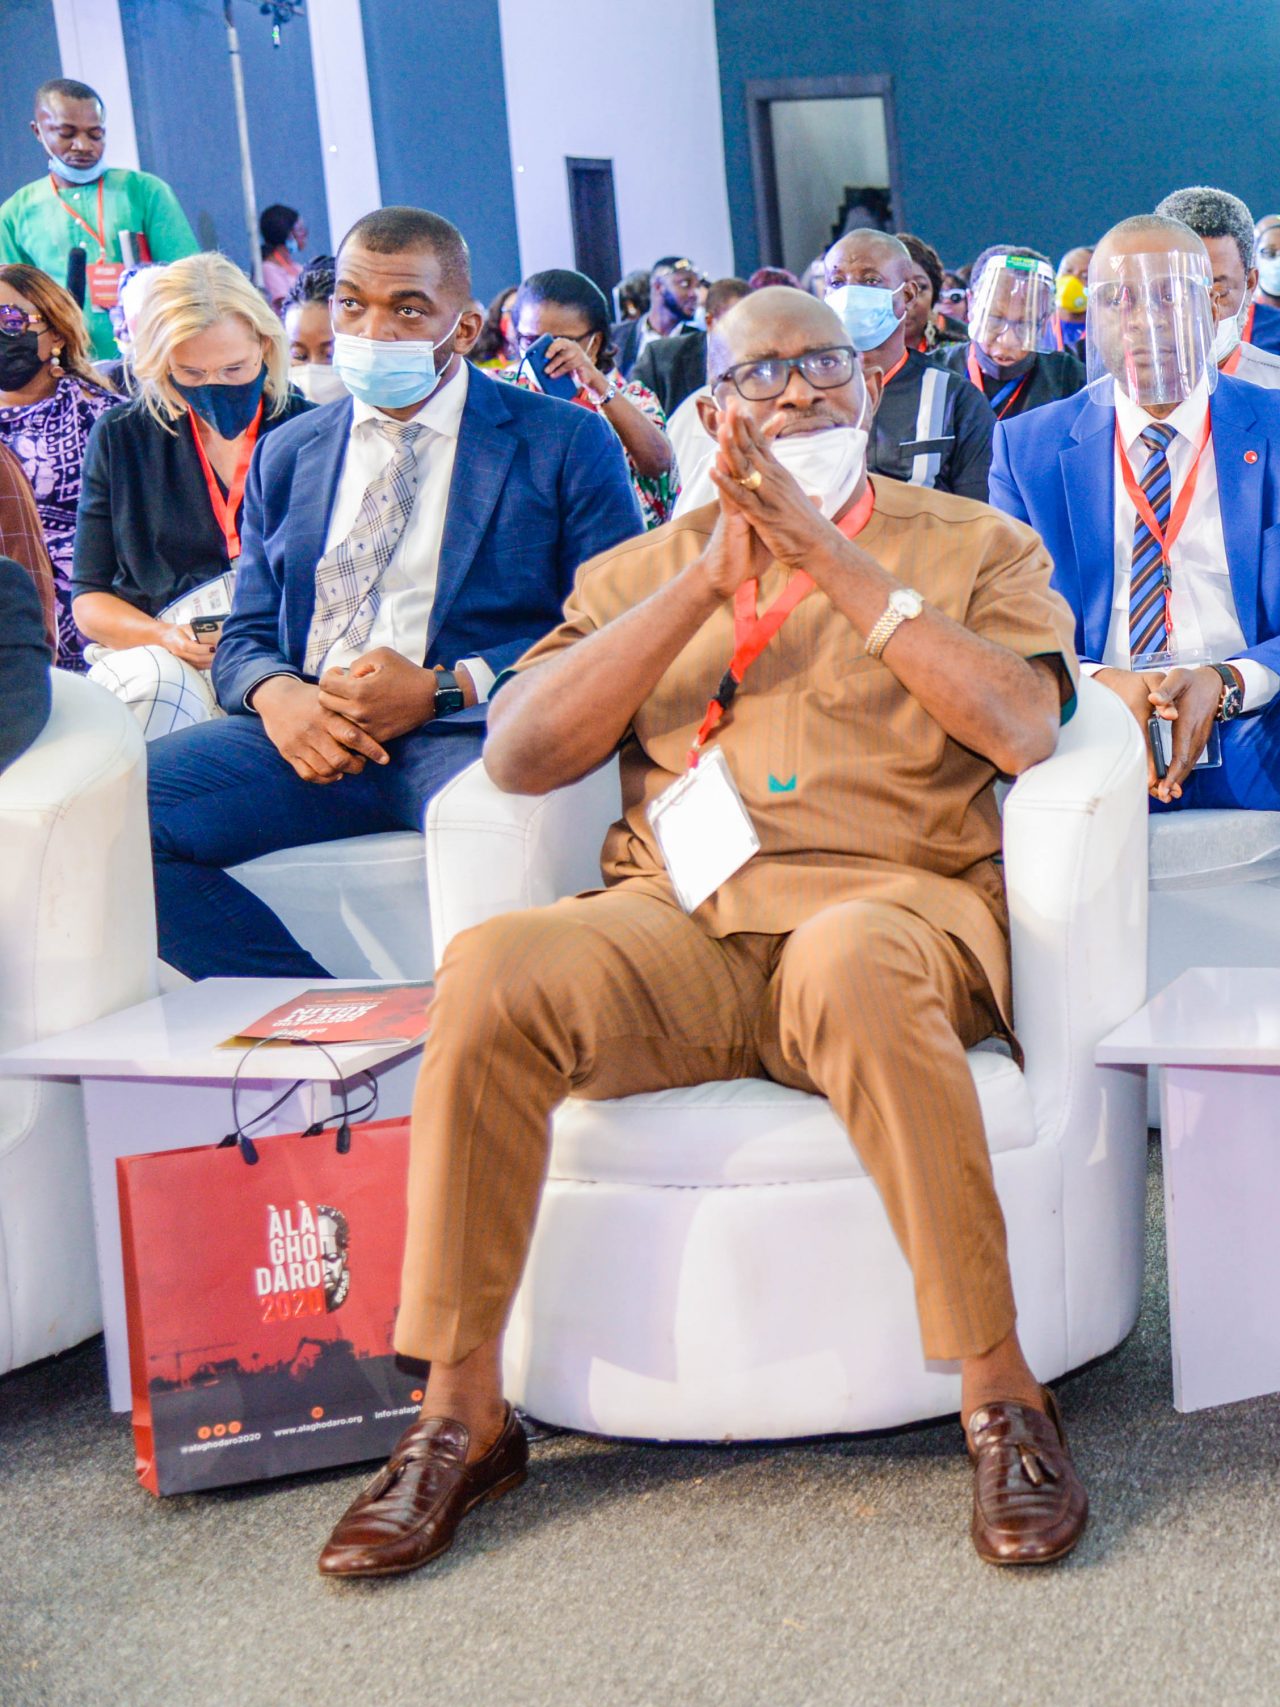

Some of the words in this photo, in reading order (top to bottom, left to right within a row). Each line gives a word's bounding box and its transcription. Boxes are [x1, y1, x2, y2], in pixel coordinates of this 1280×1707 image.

[269, 1233, 319, 1266] GHO
[256, 1260, 320, 1296] DARO
[261, 1289, 323, 1323] 2020
[274, 1415, 363, 1437] www.alaghodaro.org
[374, 1405, 424, 1420] info@alagh
